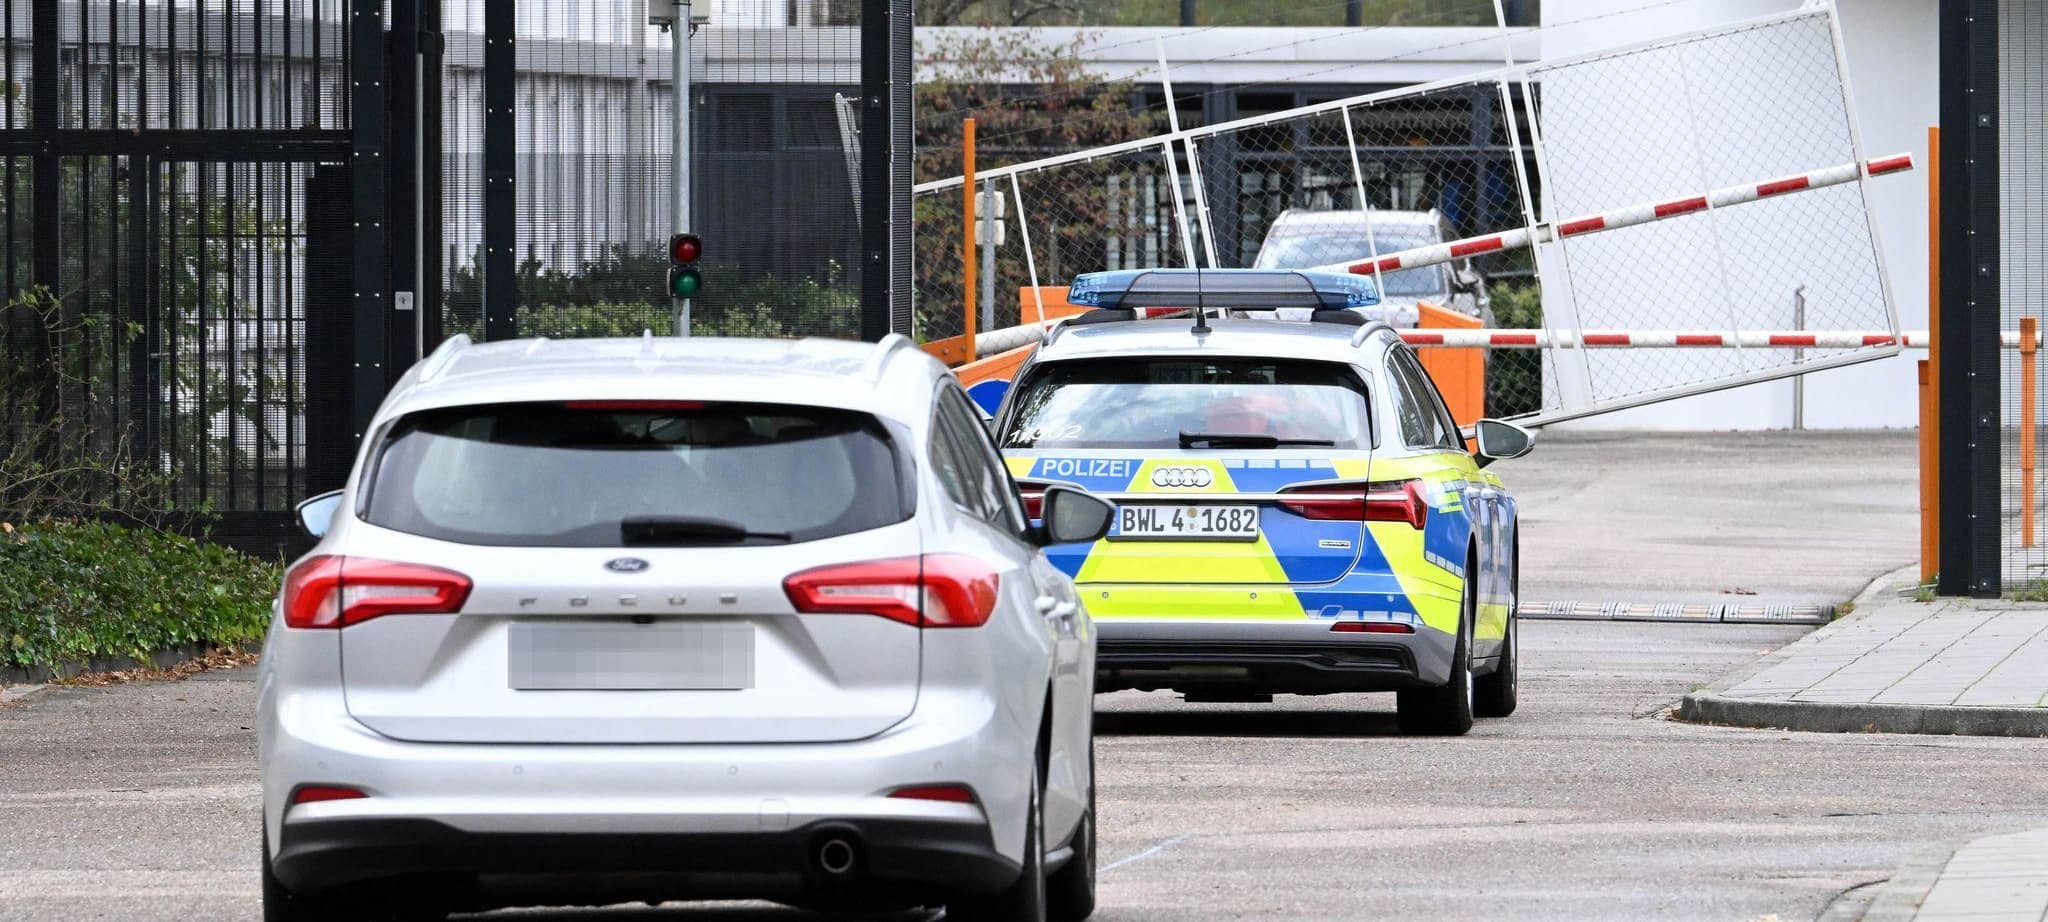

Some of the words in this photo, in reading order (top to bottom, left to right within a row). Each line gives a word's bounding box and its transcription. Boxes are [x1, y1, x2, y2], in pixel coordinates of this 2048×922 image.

[1042, 459, 1131, 477] POLIZEI
[1122, 508, 1165, 532] BWL
[1171, 508, 1184, 532] 4
[1201, 508, 1256, 532] 1682
